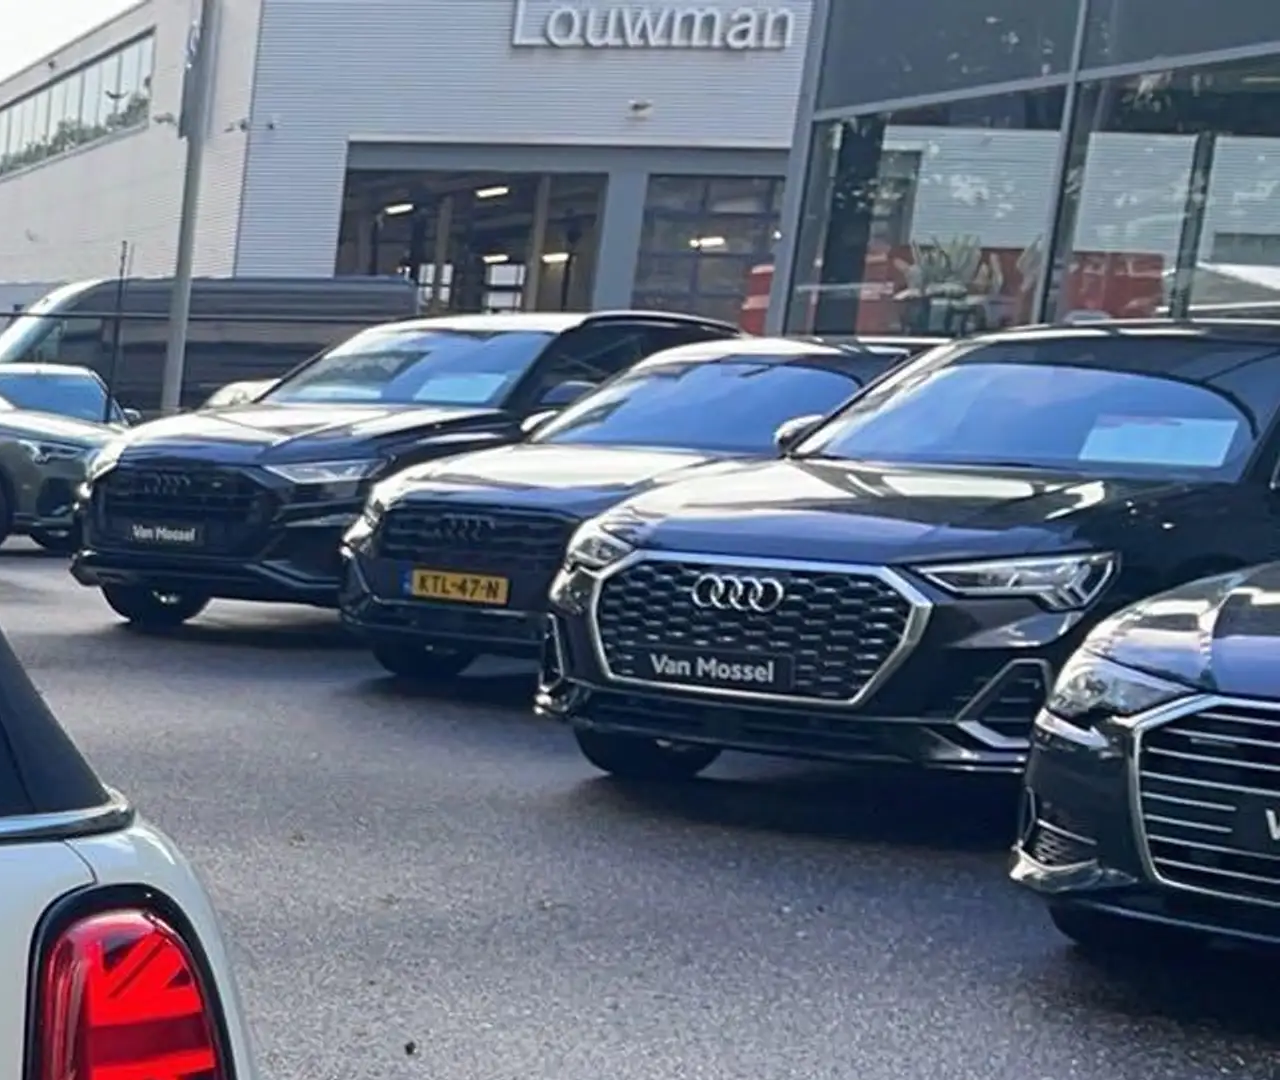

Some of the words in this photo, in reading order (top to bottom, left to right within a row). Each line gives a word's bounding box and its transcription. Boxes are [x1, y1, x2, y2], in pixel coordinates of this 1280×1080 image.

[512, 0, 796, 50] Louwman
[417, 574, 501, 600] KTL-47-N
[649, 653, 690, 676] Van
[695, 656, 775, 683] Mossel
